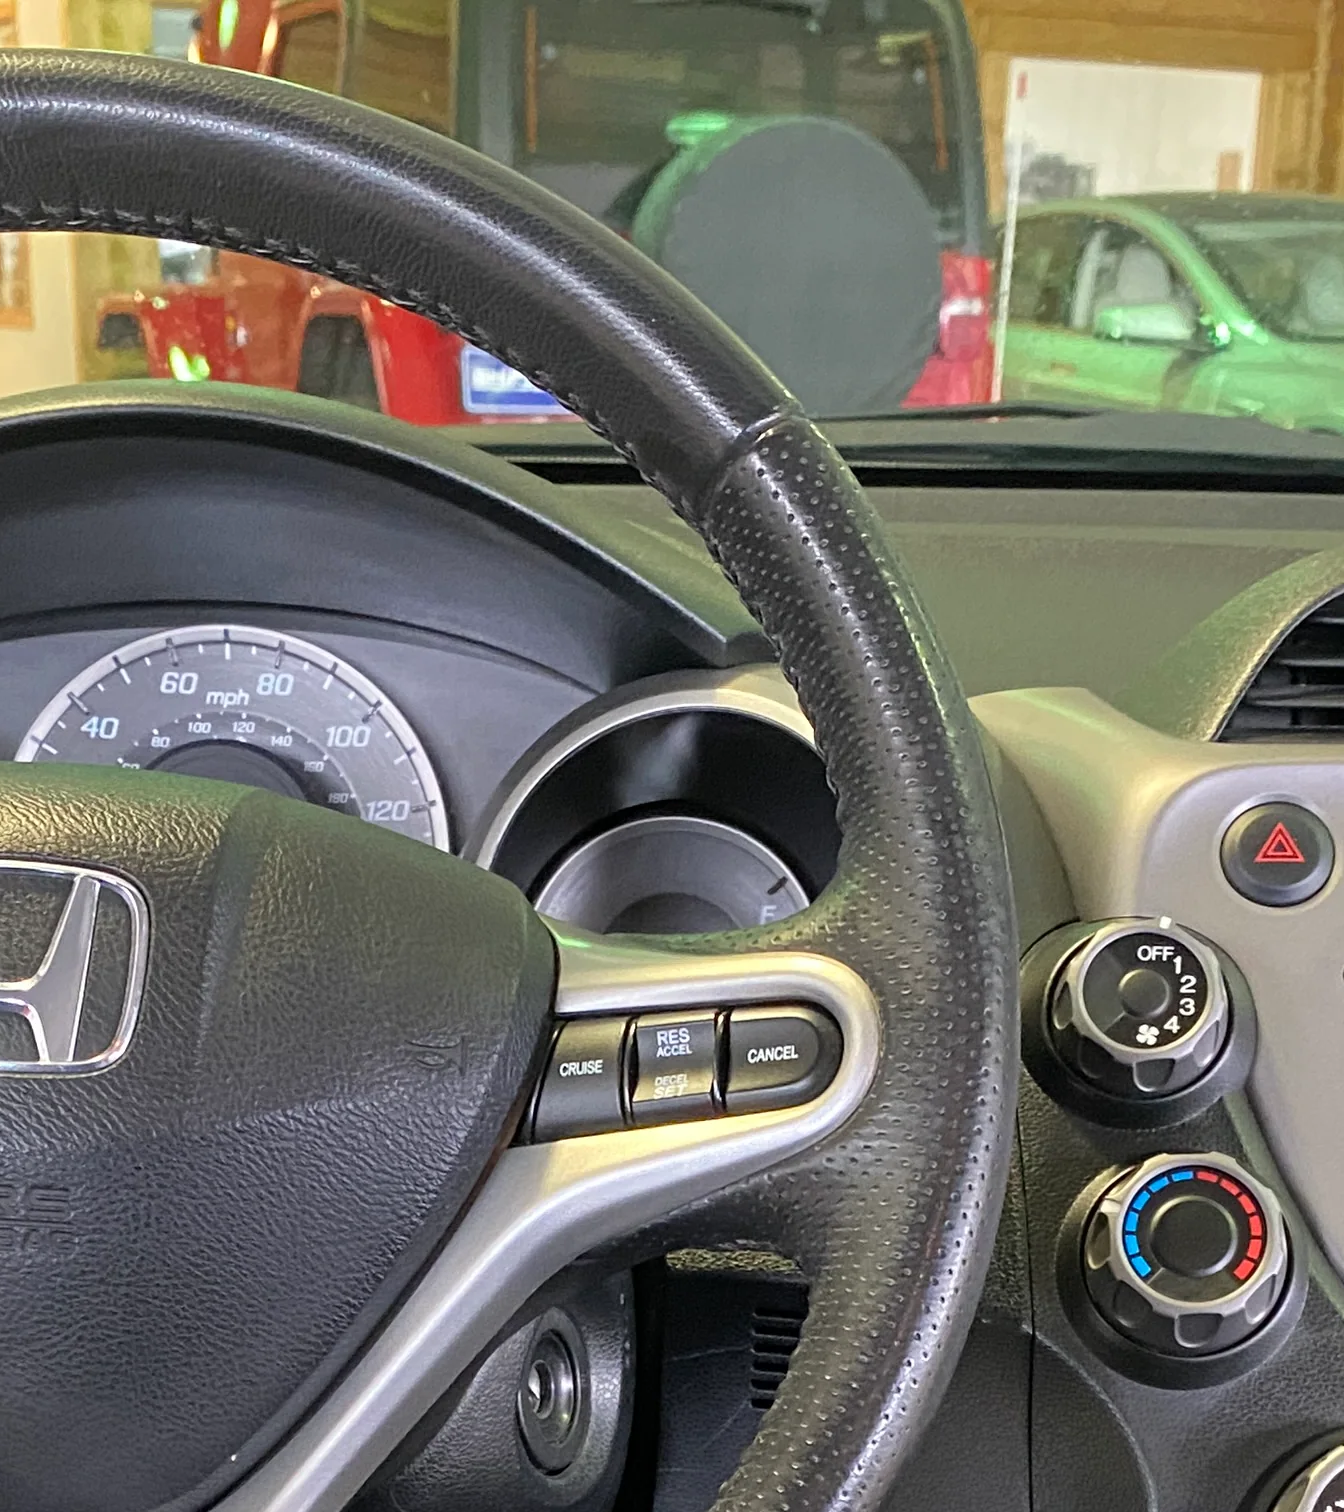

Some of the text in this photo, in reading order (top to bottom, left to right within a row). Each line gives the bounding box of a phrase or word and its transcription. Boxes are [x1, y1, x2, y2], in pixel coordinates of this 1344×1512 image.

[159, 671, 199, 695] 60
[257, 673, 293, 695] 80
[206, 688, 250, 707] mph
[81, 716, 119, 739] 40
[188, 722, 212, 734] 100
[232, 721, 255, 733] 120
[271, 735, 292, 747] 140
[325, 725, 371, 748] 100
[365, 800, 411, 822] 120
[1137, 945, 1175, 962] OFF
[1172, 956, 1183, 975] 1
[1179, 975, 1197, 994] 2
[1179, 998, 1196, 1016] 3
[1163, 1015, 1181, 1034] 4
[656, 1027, 690, 1045] RES
[655, 1043, 693, 1058] ACCEL
[747, 1045, 799, 1064] CANCEL
[559, 1059, 603, 1077] CRUISE
[654, 1073, 689, 1087] DECEL
[653, 1084, 688, 1099] SET
